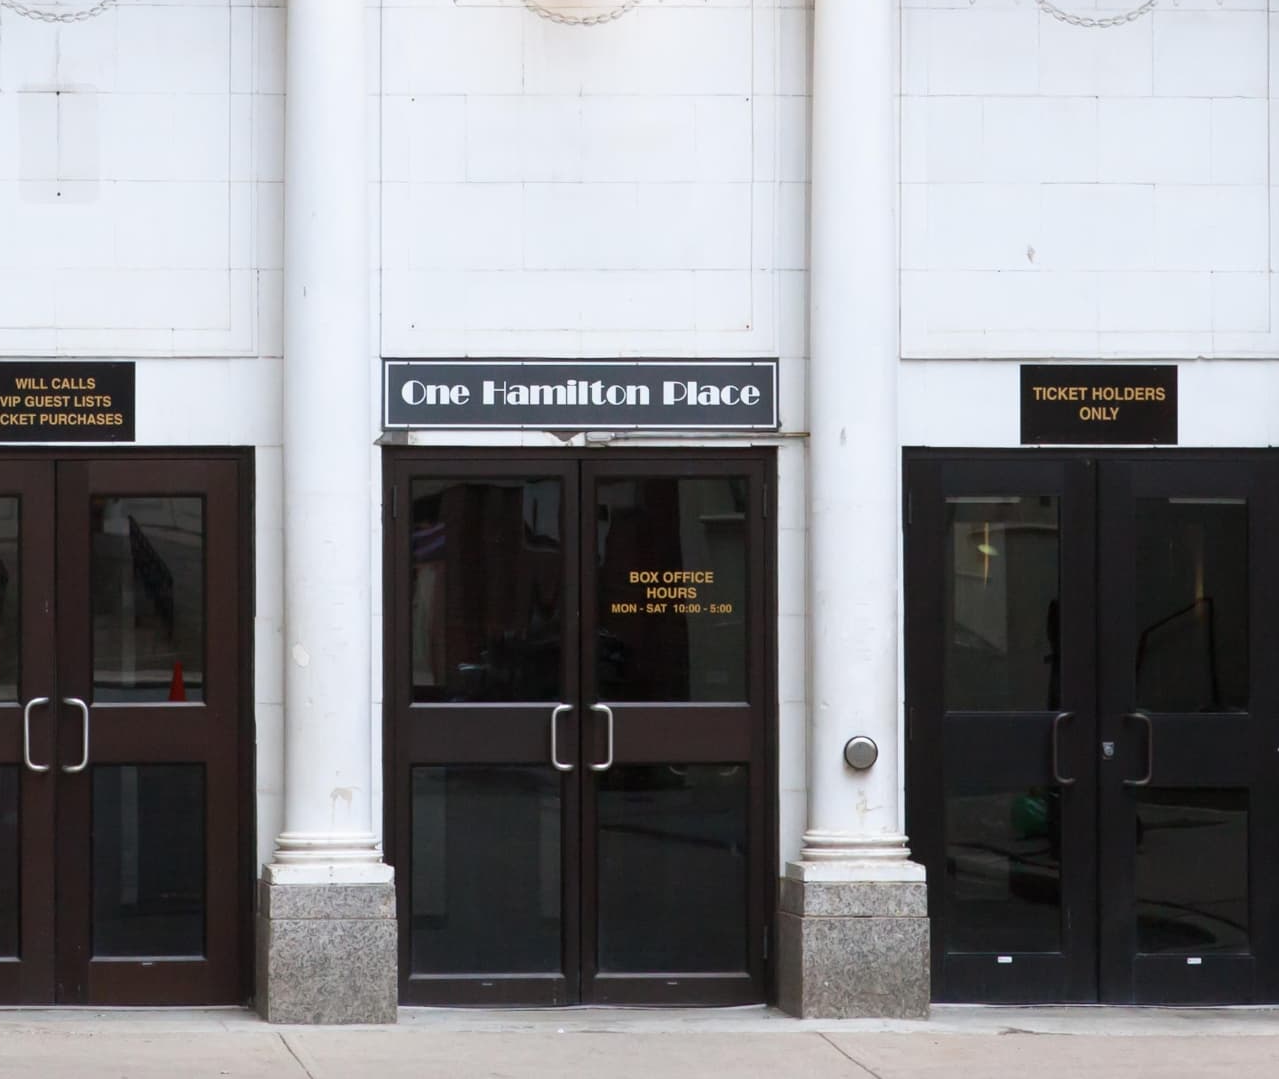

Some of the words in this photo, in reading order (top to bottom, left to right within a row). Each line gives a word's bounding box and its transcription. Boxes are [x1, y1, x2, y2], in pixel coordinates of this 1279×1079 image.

[15, 377, 49, 390] WILL
[51, 377, 96, 390] CALLS
[401, 379, 470, 406] One
[482, 379, 650, 406] Hamilton
[662, 380, 761, 406] Place
[1032, 387, 1088, 401] TICKET
[1092, 387, 1166, 401] HOLDERS
[0, 396, 21, 408] VIP
[24, 396, 70, 408] GUEST
[74, 396, 112, 408] LISTS
[39, 413, 124, 426] PURCHASES
[1079, 407, 1120, 420] ONLY
[629, 571, 659, 584] BOX
[662, 571, 714, 584] OFFICE
[646, 587, 698, 600] HOURS
[611, 603, 636, 614] MON
[646, 603, 667, 614] SAT
[673, 603, 701, 614] 10:00
[710, 603, 732, 614] 5:00
